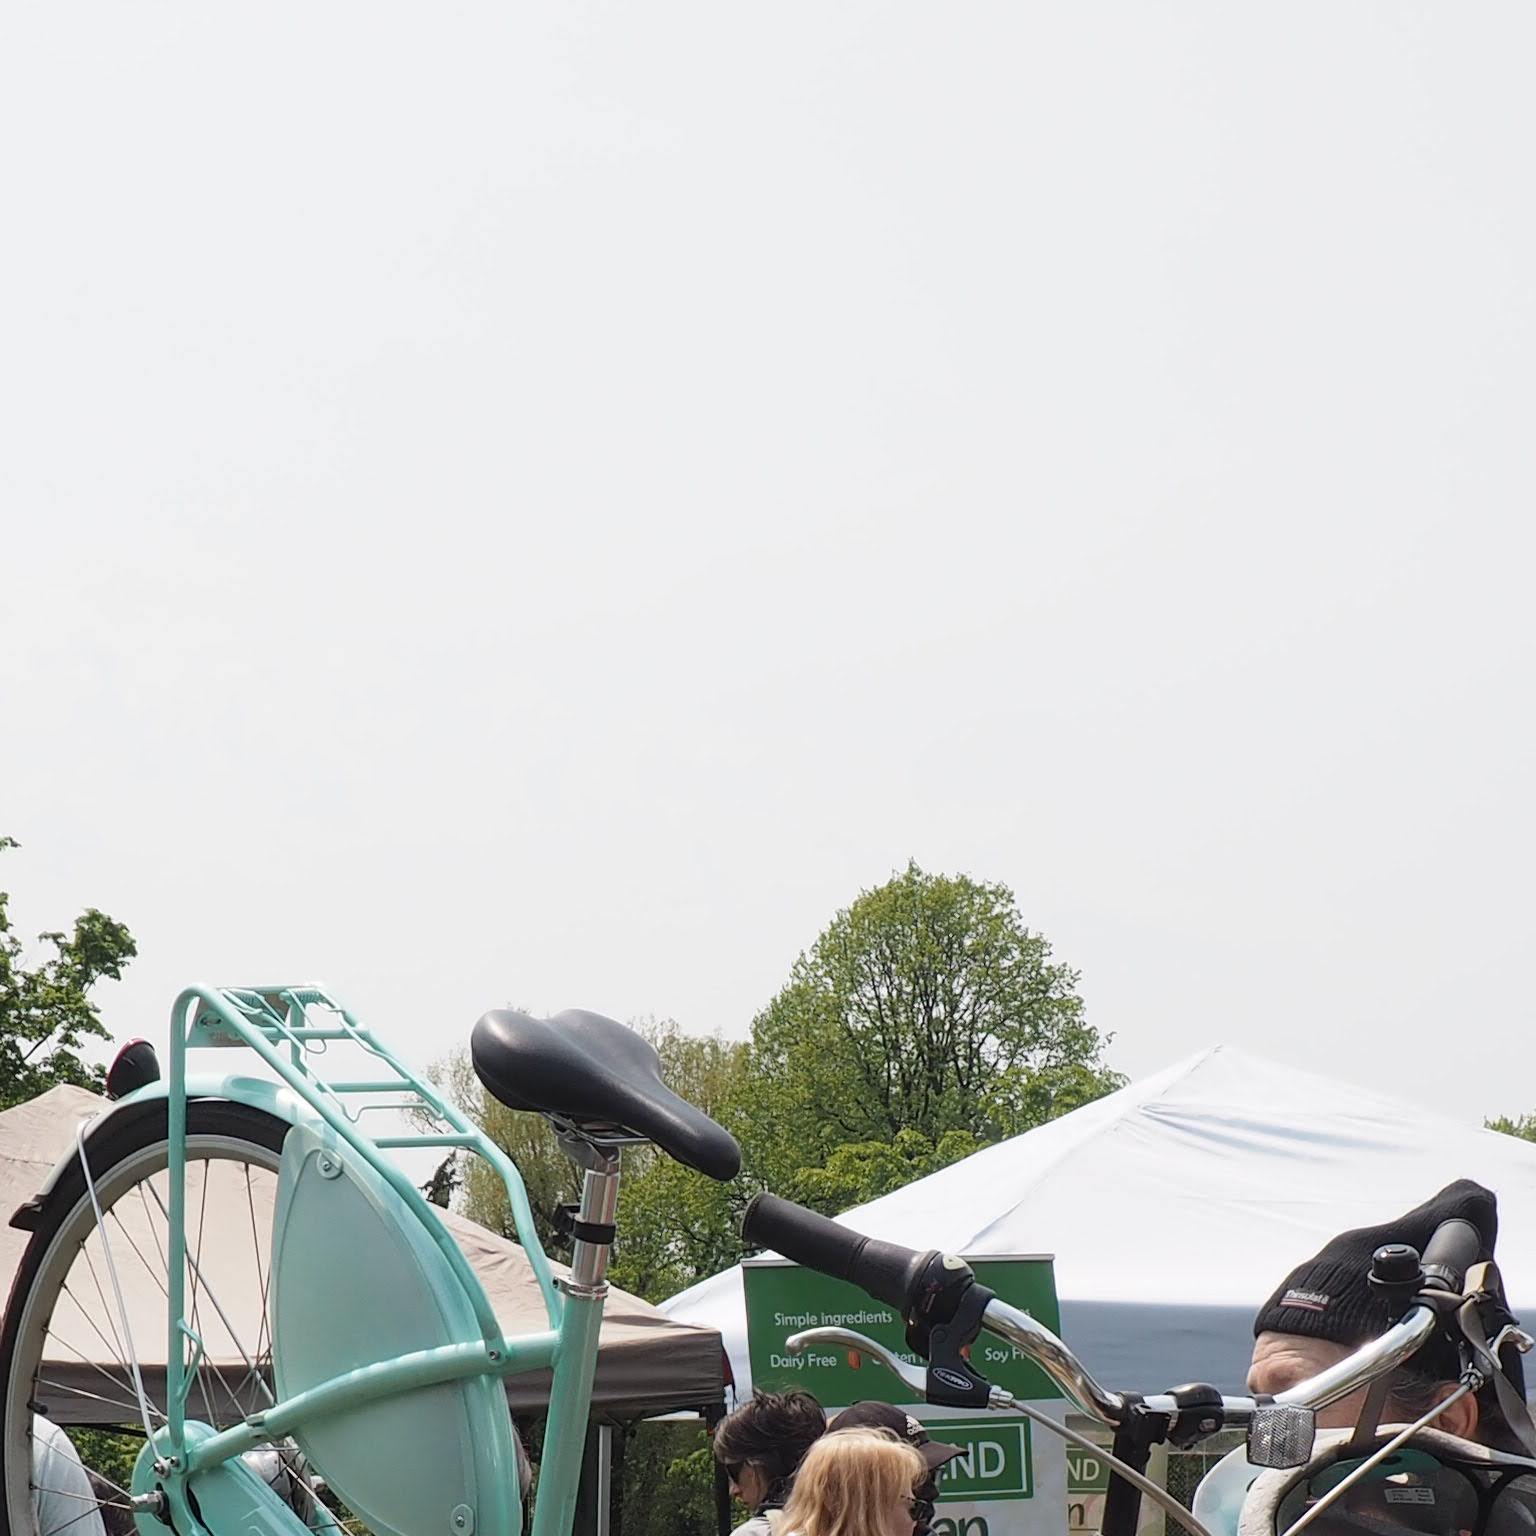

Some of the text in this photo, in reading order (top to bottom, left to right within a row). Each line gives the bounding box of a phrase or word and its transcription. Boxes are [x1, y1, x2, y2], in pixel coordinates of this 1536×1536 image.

[774, 1311, 893, 1328] Simple ingredients
[770, 1353, 838, 1370] Dairy Free
[985, 1347, 1028, 1363] Soy Fr
[941, 1441, 1006, 1480] ND
